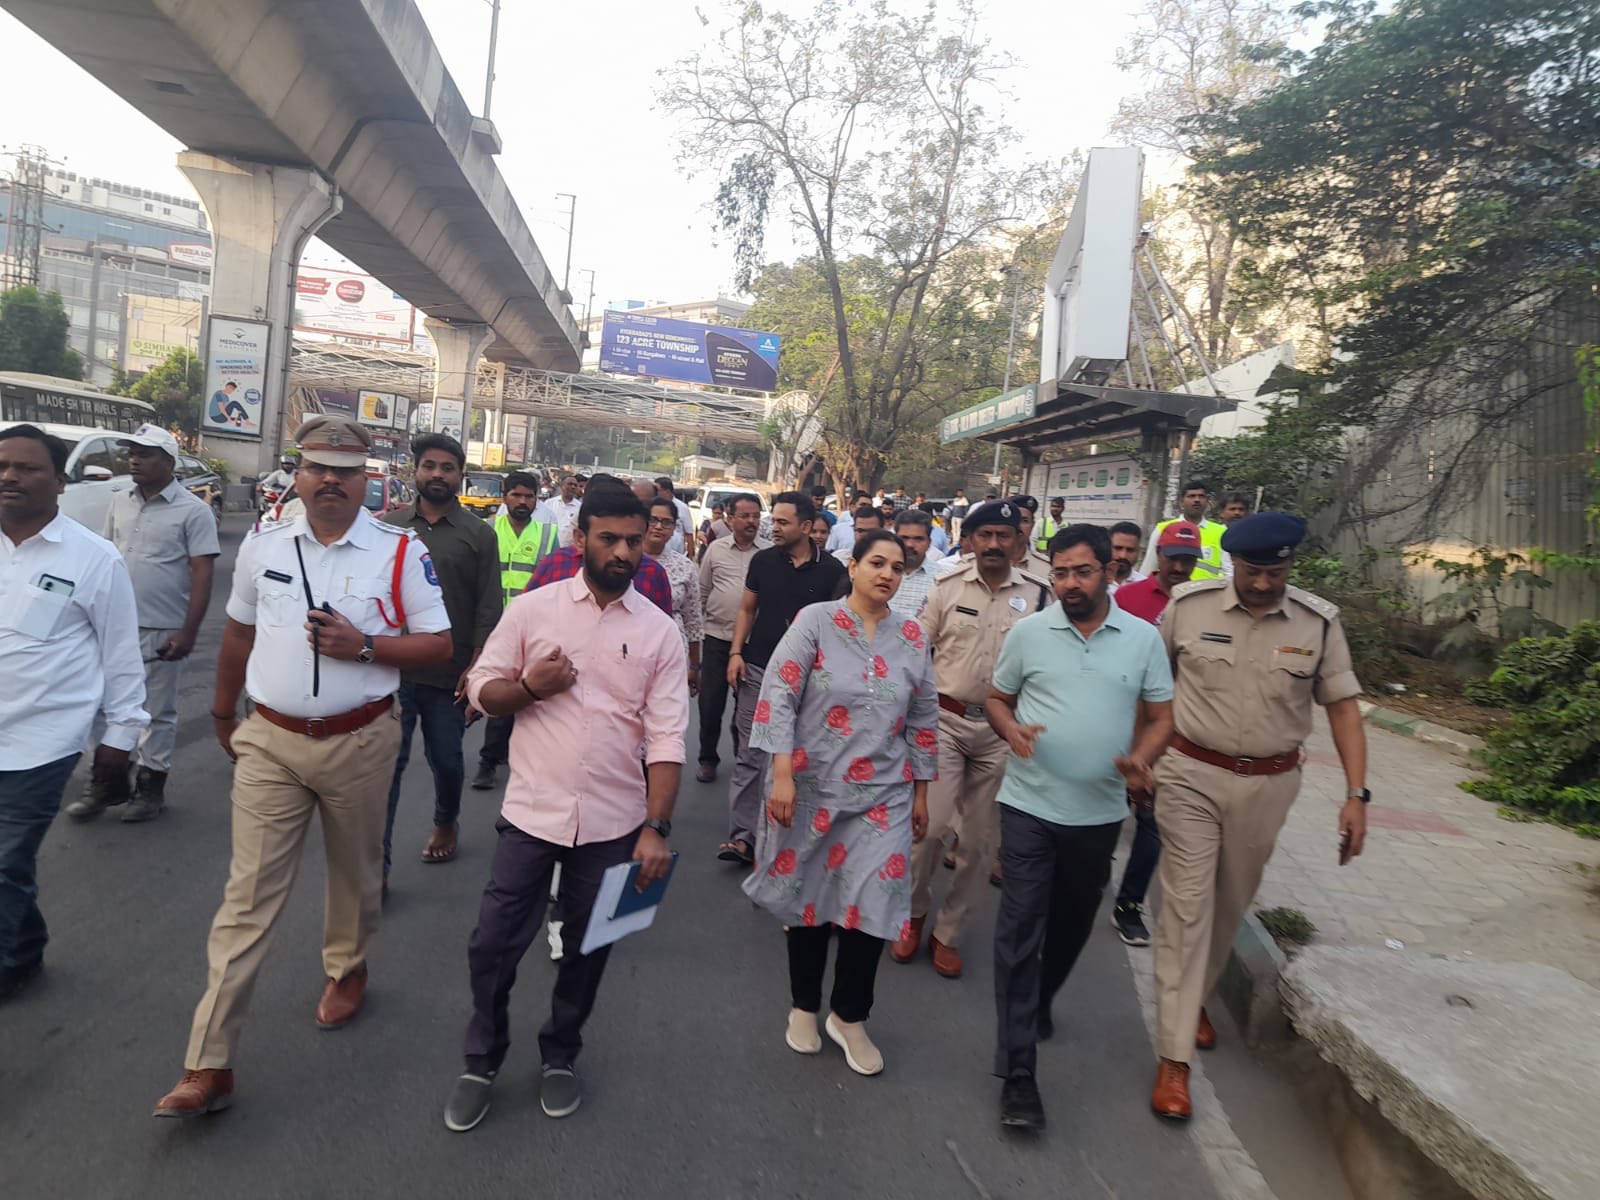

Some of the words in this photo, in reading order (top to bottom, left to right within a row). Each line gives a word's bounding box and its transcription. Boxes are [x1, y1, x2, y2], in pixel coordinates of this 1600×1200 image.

[219, 338, 257, 348] MEDICOVER
[616, 334, 630, 345] 123
[631, 336, 655, 348] ACRE
[655, 339, 700, 354] TOWNSHIP
